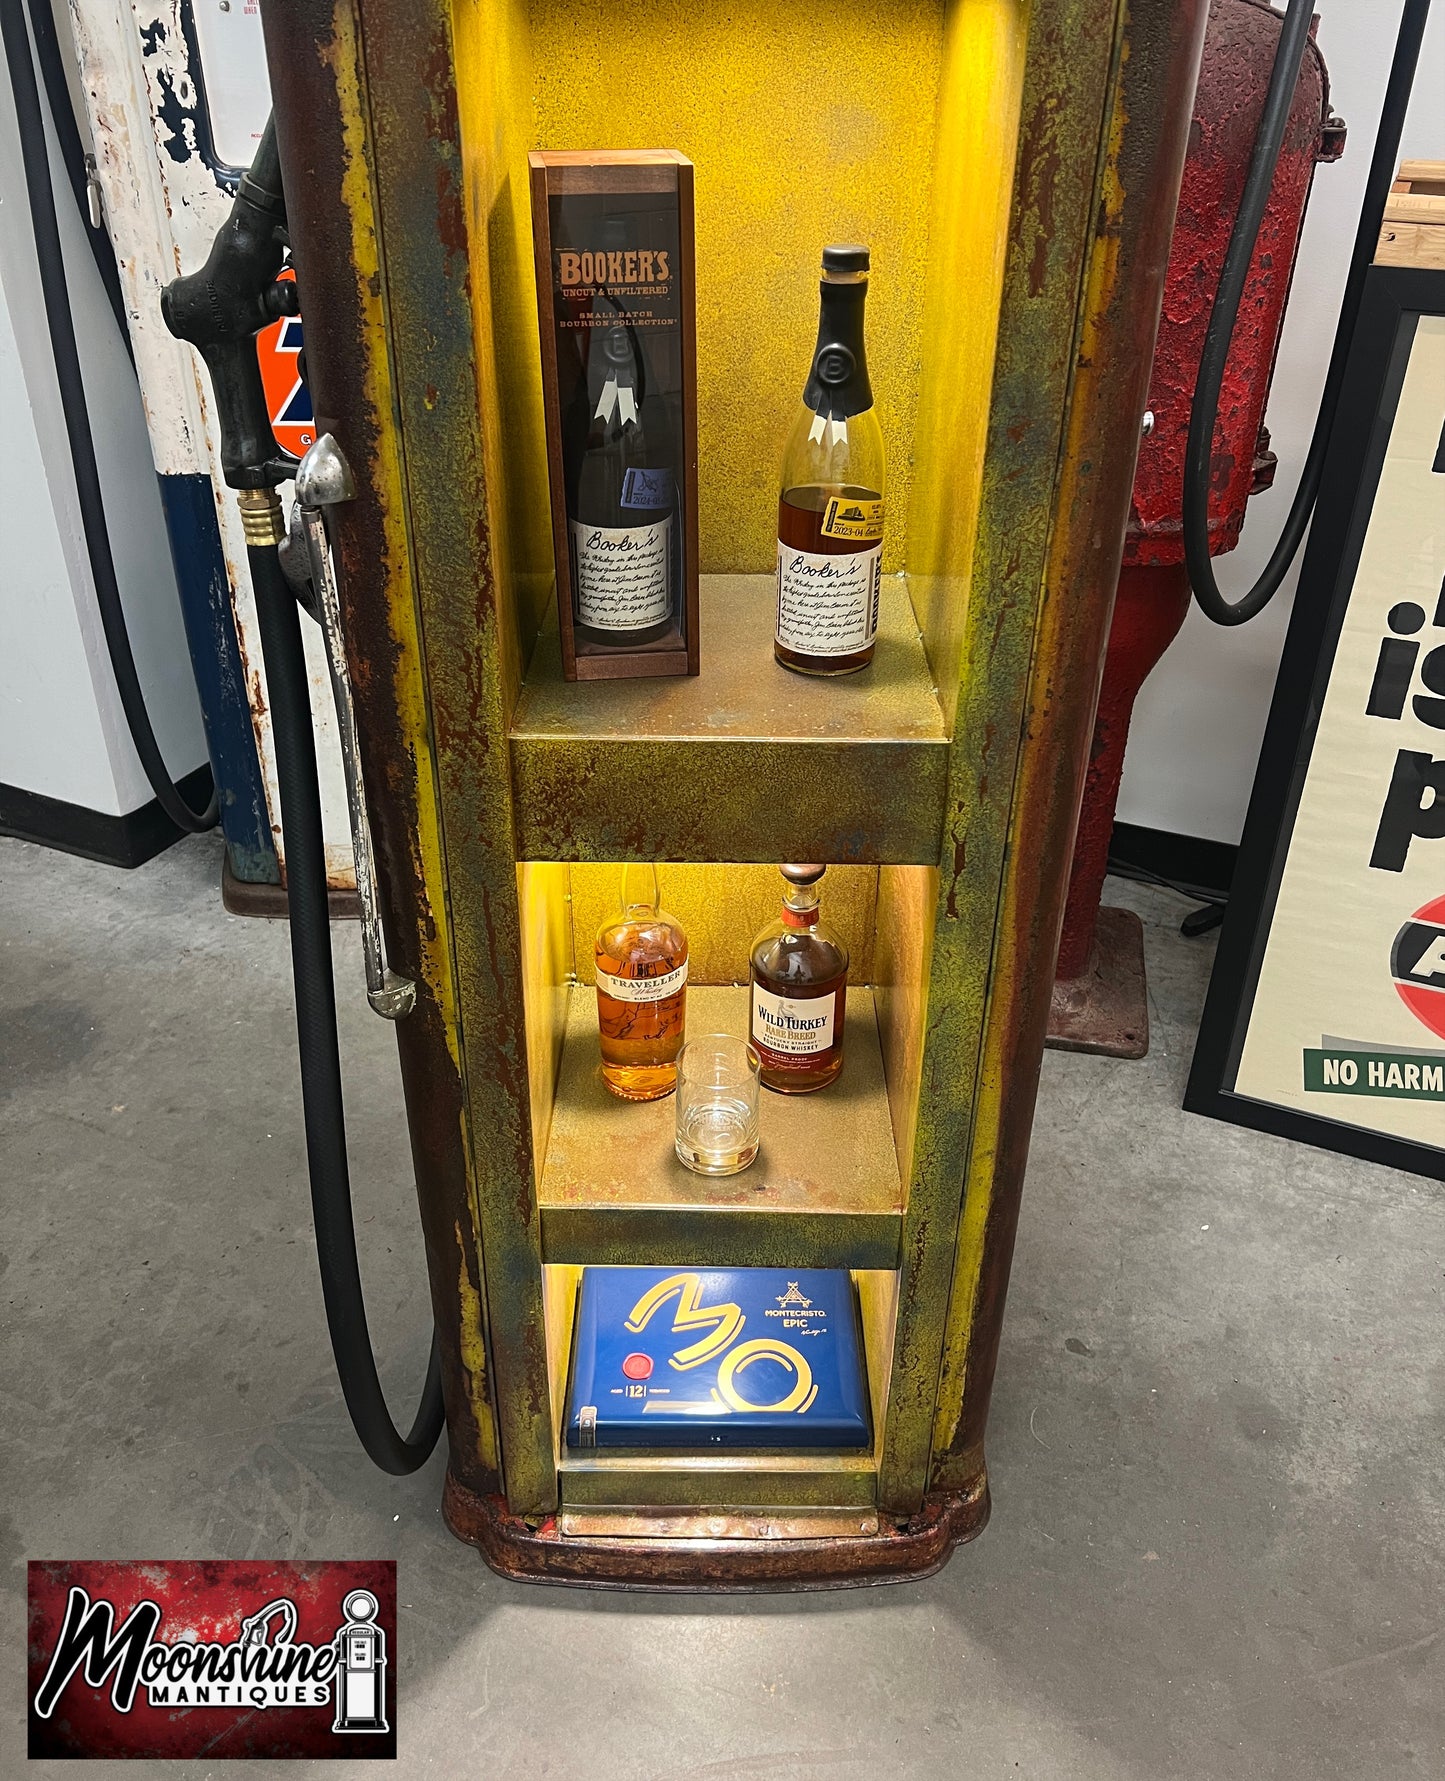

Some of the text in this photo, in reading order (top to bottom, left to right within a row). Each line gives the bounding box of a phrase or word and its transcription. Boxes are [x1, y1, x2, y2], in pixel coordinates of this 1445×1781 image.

[560, 251, 670, 285] BOOKER'S
[562, 286, 669, 298] UNCUT & UNFILTERED
[560, 320, 609, 328] BOURBON
[586, 529, 659, 551] Booker's
[789, 555, 862, 579] Booker's
[611, 970, 681, 989] TRAVELLER
[758, 1005, 828, 1031] WILD TURKEY
[766, 1024, 816, 1041] RARE BREED
[763, 1037, 789, 1050] BOURBON
[1323, 1058, 1443, 1092] NO HARM
[783, 1319, 808, 1328] EPIC
